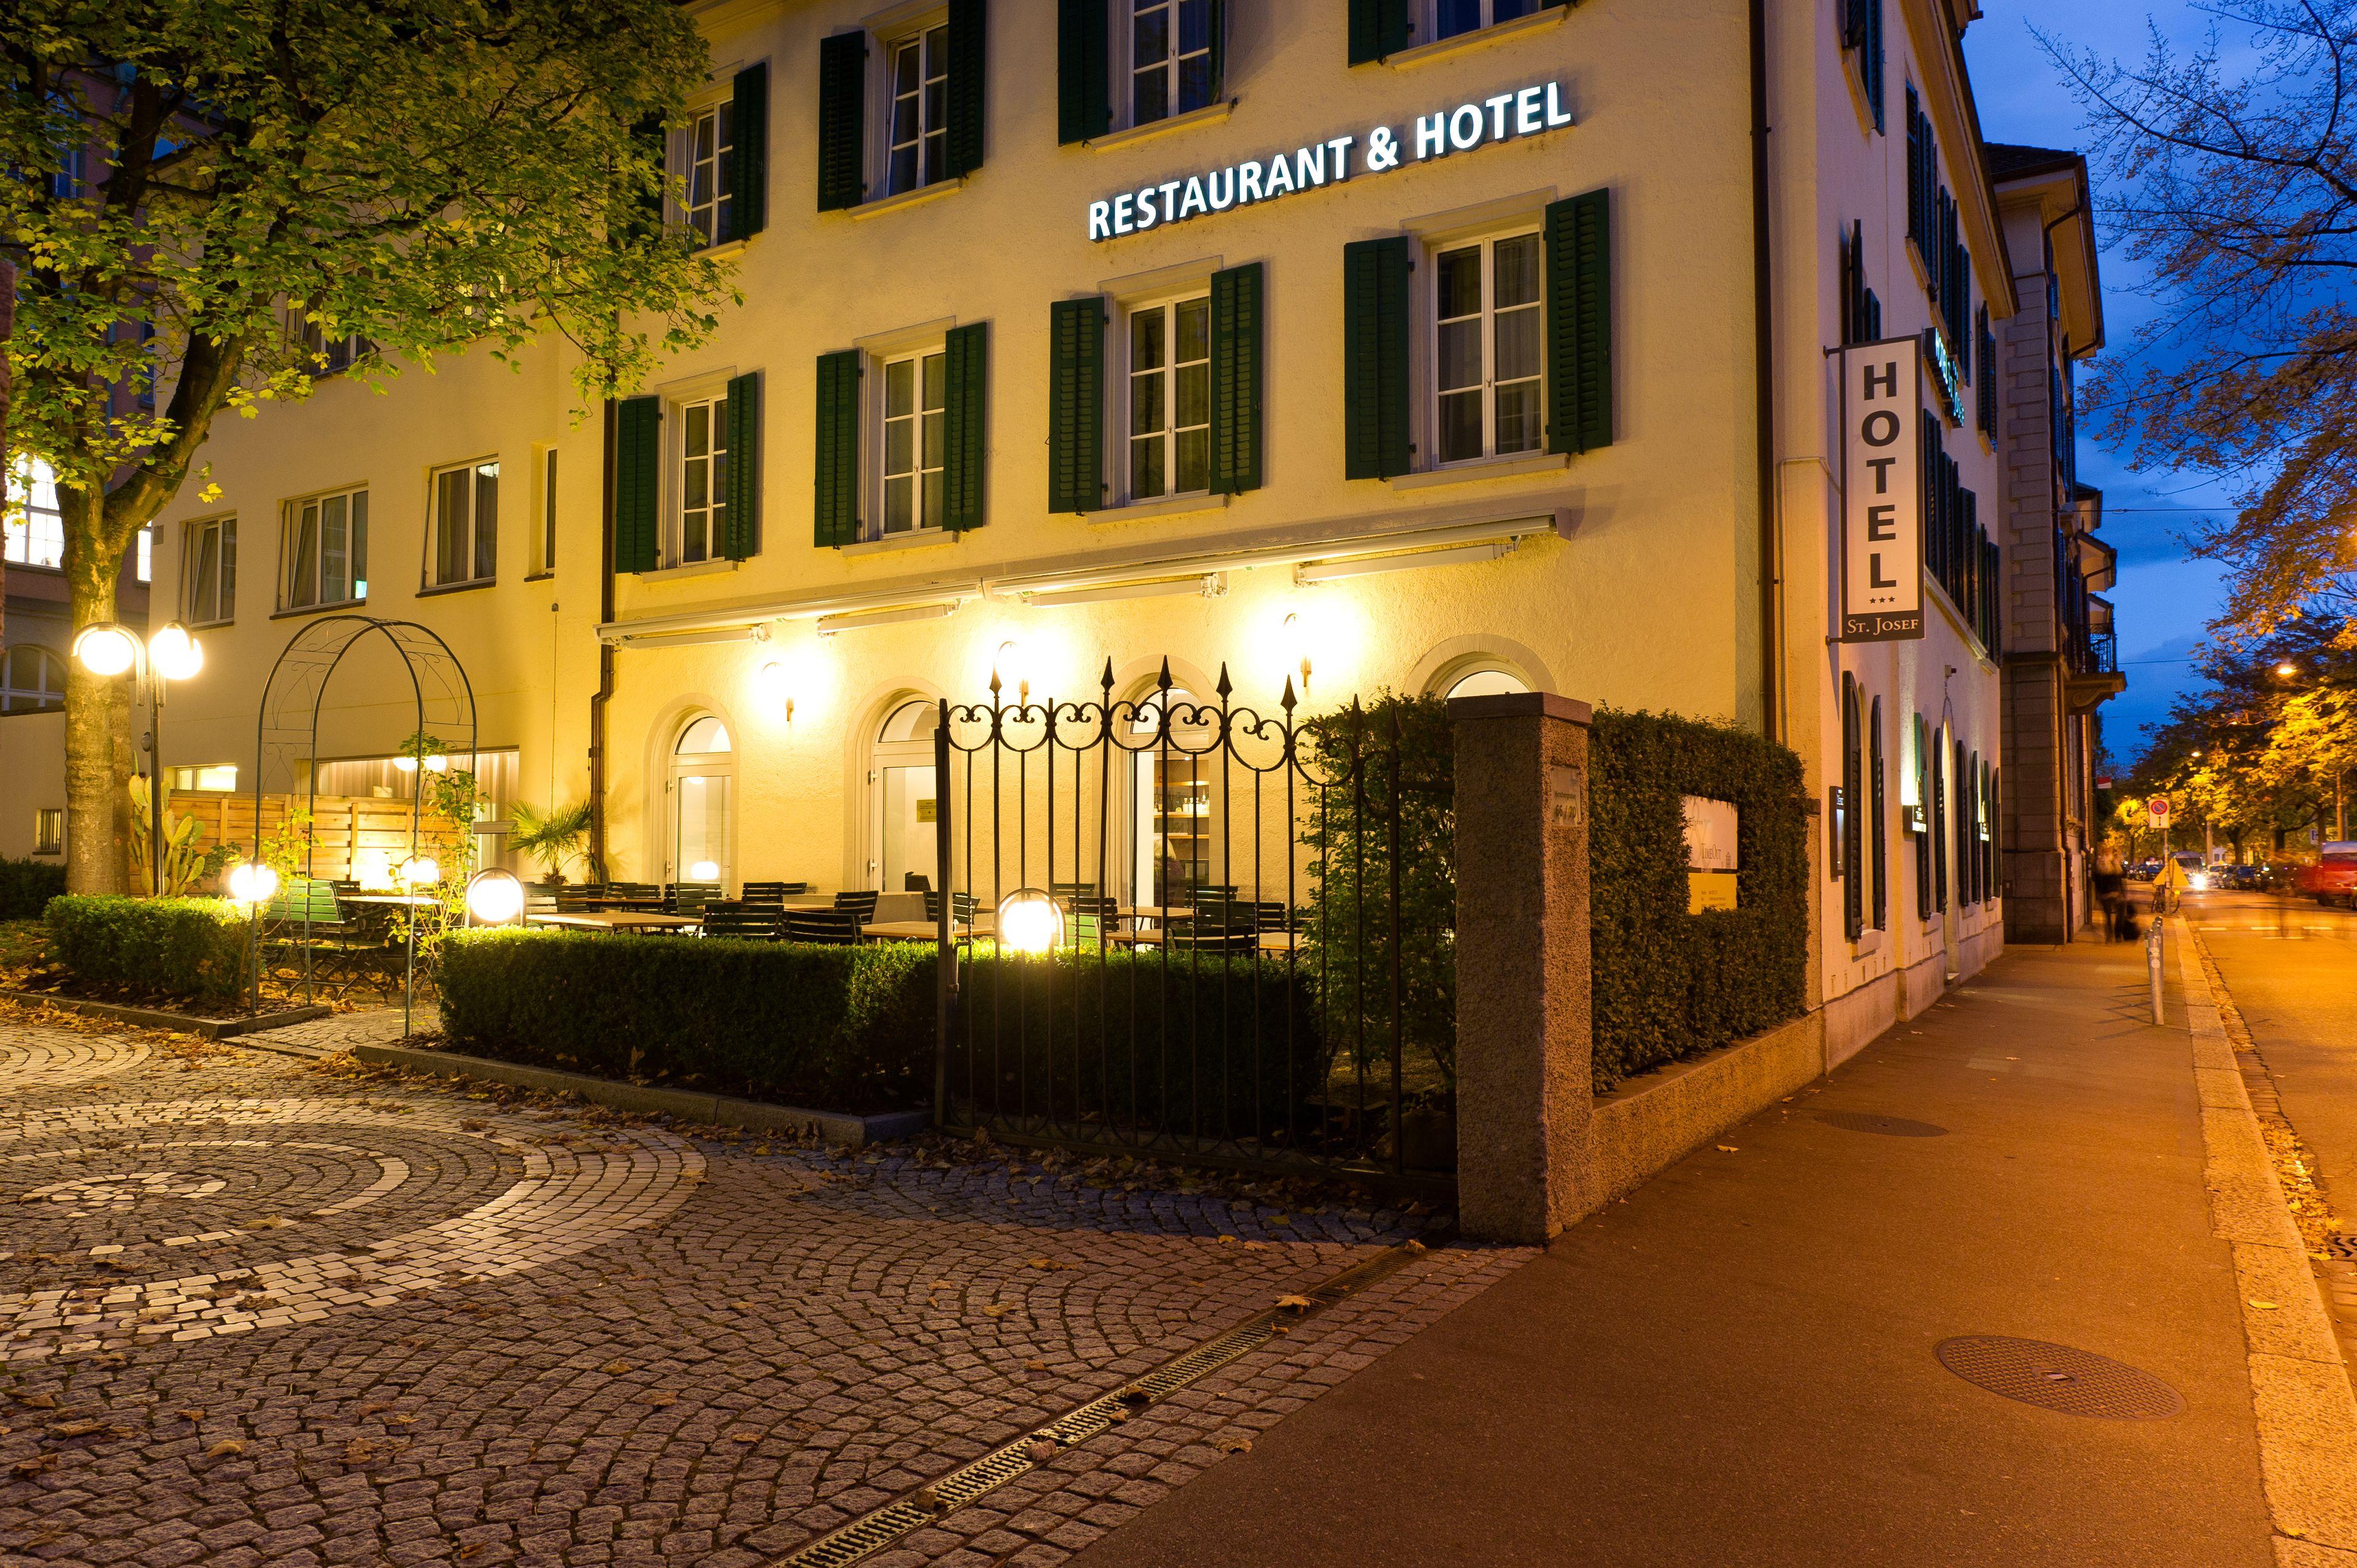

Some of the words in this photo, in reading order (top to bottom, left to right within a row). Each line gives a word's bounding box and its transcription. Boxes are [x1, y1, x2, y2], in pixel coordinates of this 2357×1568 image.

[1088, 136, 1354, 241] RESTAURANT
[1366, 126, 1400, 171] &
[1416, 80, 1573, 159] HOTEL
[1861, 361, 1900, 589] HOTEL
